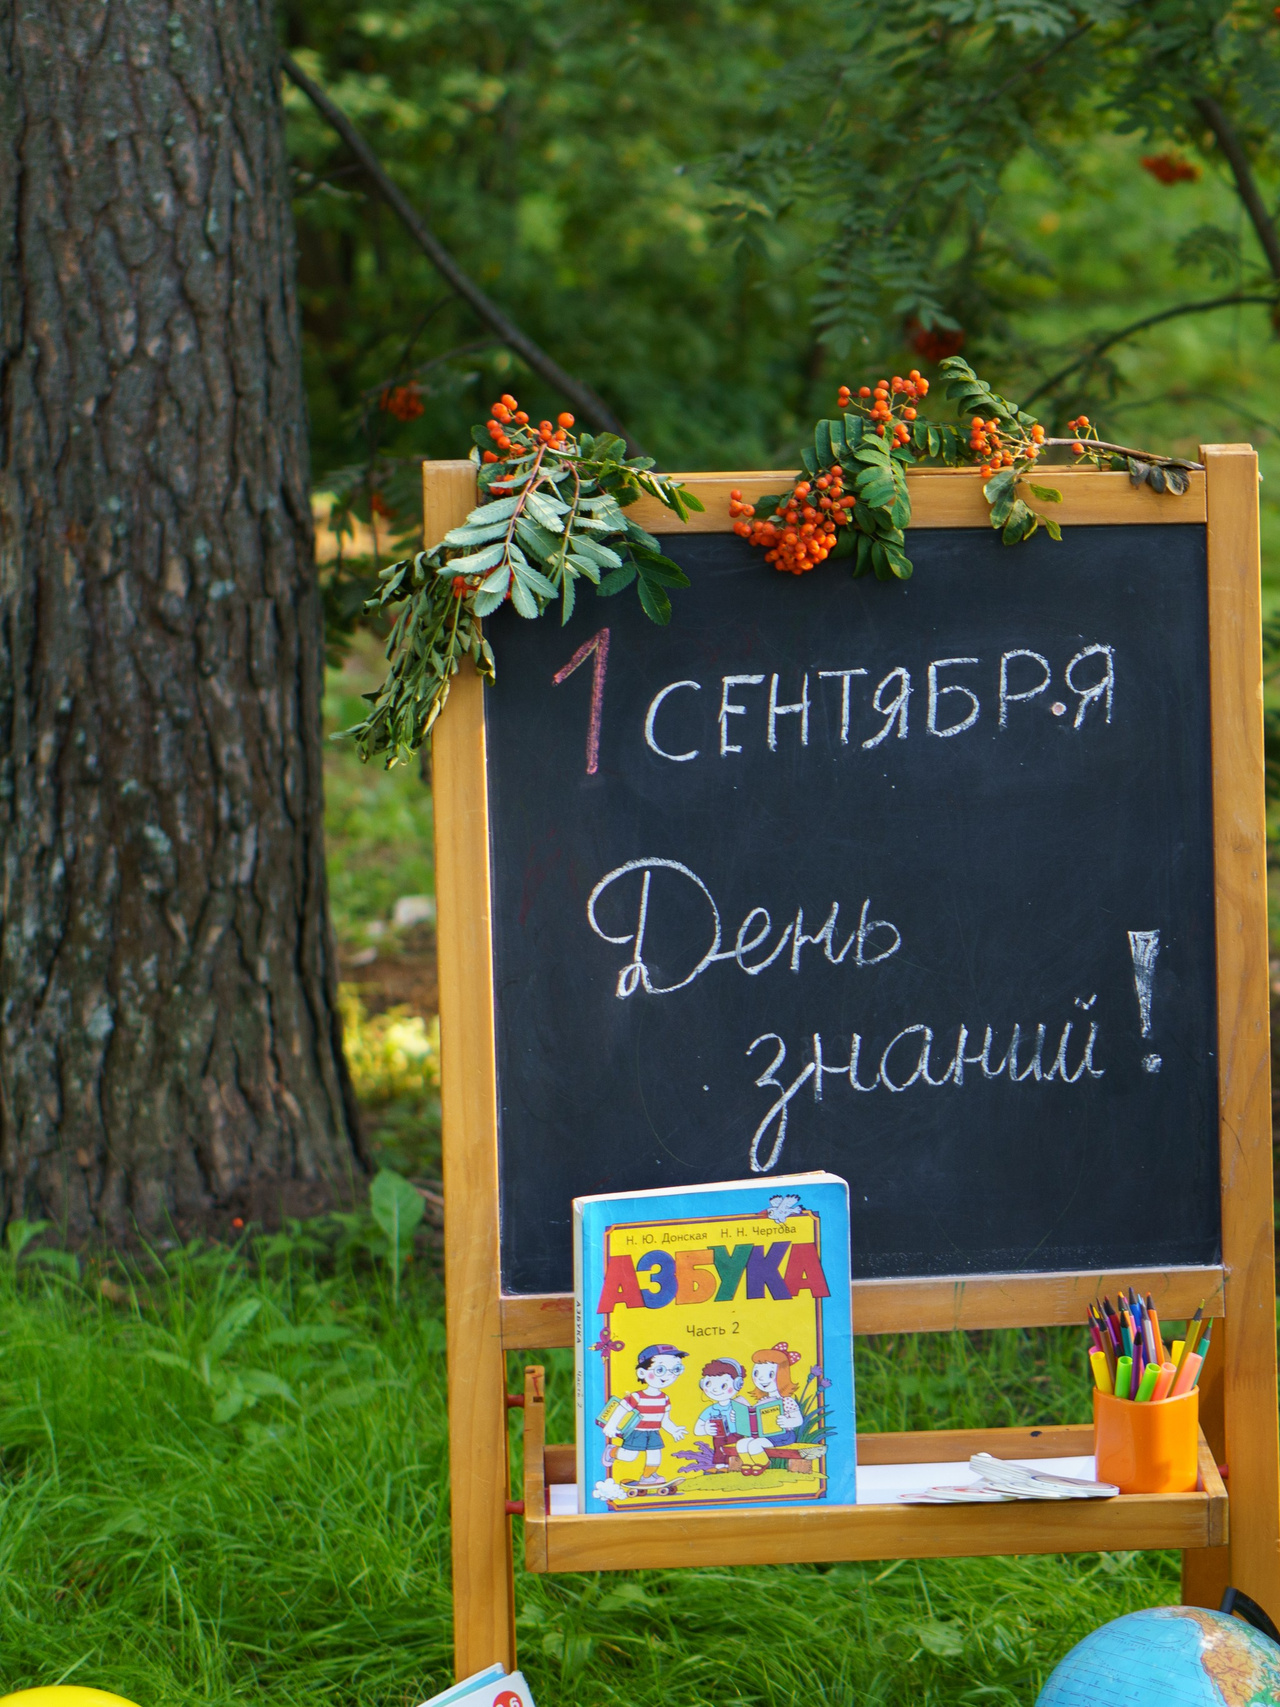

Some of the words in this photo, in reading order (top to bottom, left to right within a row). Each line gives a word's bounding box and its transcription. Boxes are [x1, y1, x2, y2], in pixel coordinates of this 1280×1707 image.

[552, 627, 610, 775] 1
[587, 857, 901, 999] День
[626, 1235, 638, 1246] Н.
[642, 1233, 657, 1245] Ю.
[662, 1232, 708, 1245] Донская
[720, 1228, 732, 1239] Н.
[737, 1227, 748, 1237] Н.
[752, 1225, 797, 1237] Чертова
[596, 1241, 831, 1314] АЗБУКА
[686, 1323, 726, 1338] Часть
[732, 1321, 740, 1335] 2
